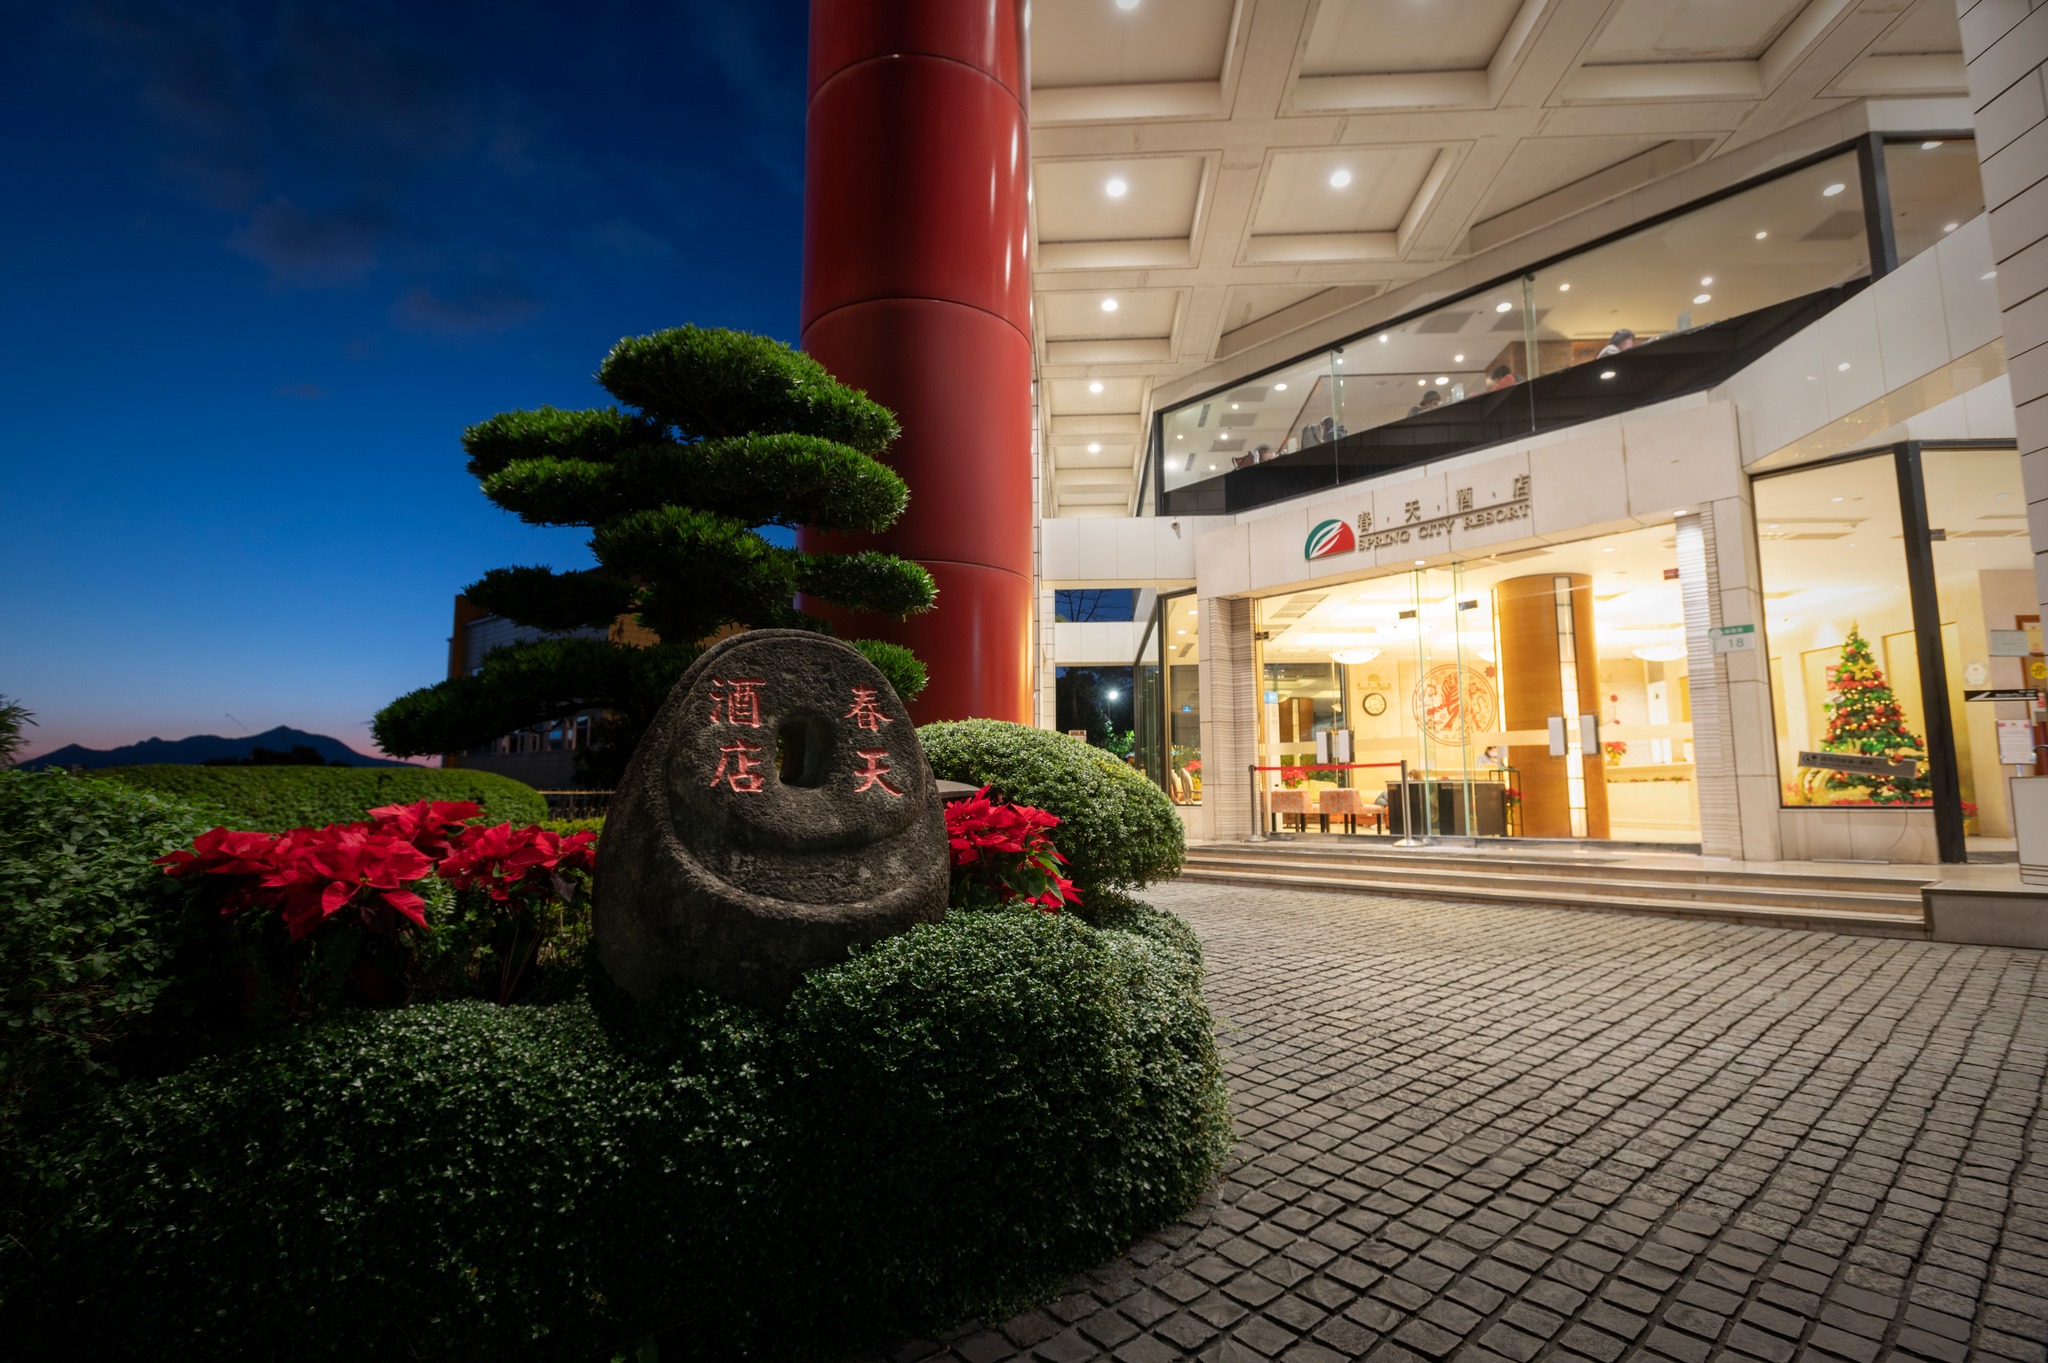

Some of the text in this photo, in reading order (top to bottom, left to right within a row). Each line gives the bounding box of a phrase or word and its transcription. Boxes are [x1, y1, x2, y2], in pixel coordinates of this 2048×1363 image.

[1358, 504, 1530, 552] SPRING CITY RESORT
[1729, 637, 1744, 648] 18
[709, 678, 767, 793] 酒店
[844, 684, 903, 797] 春天
